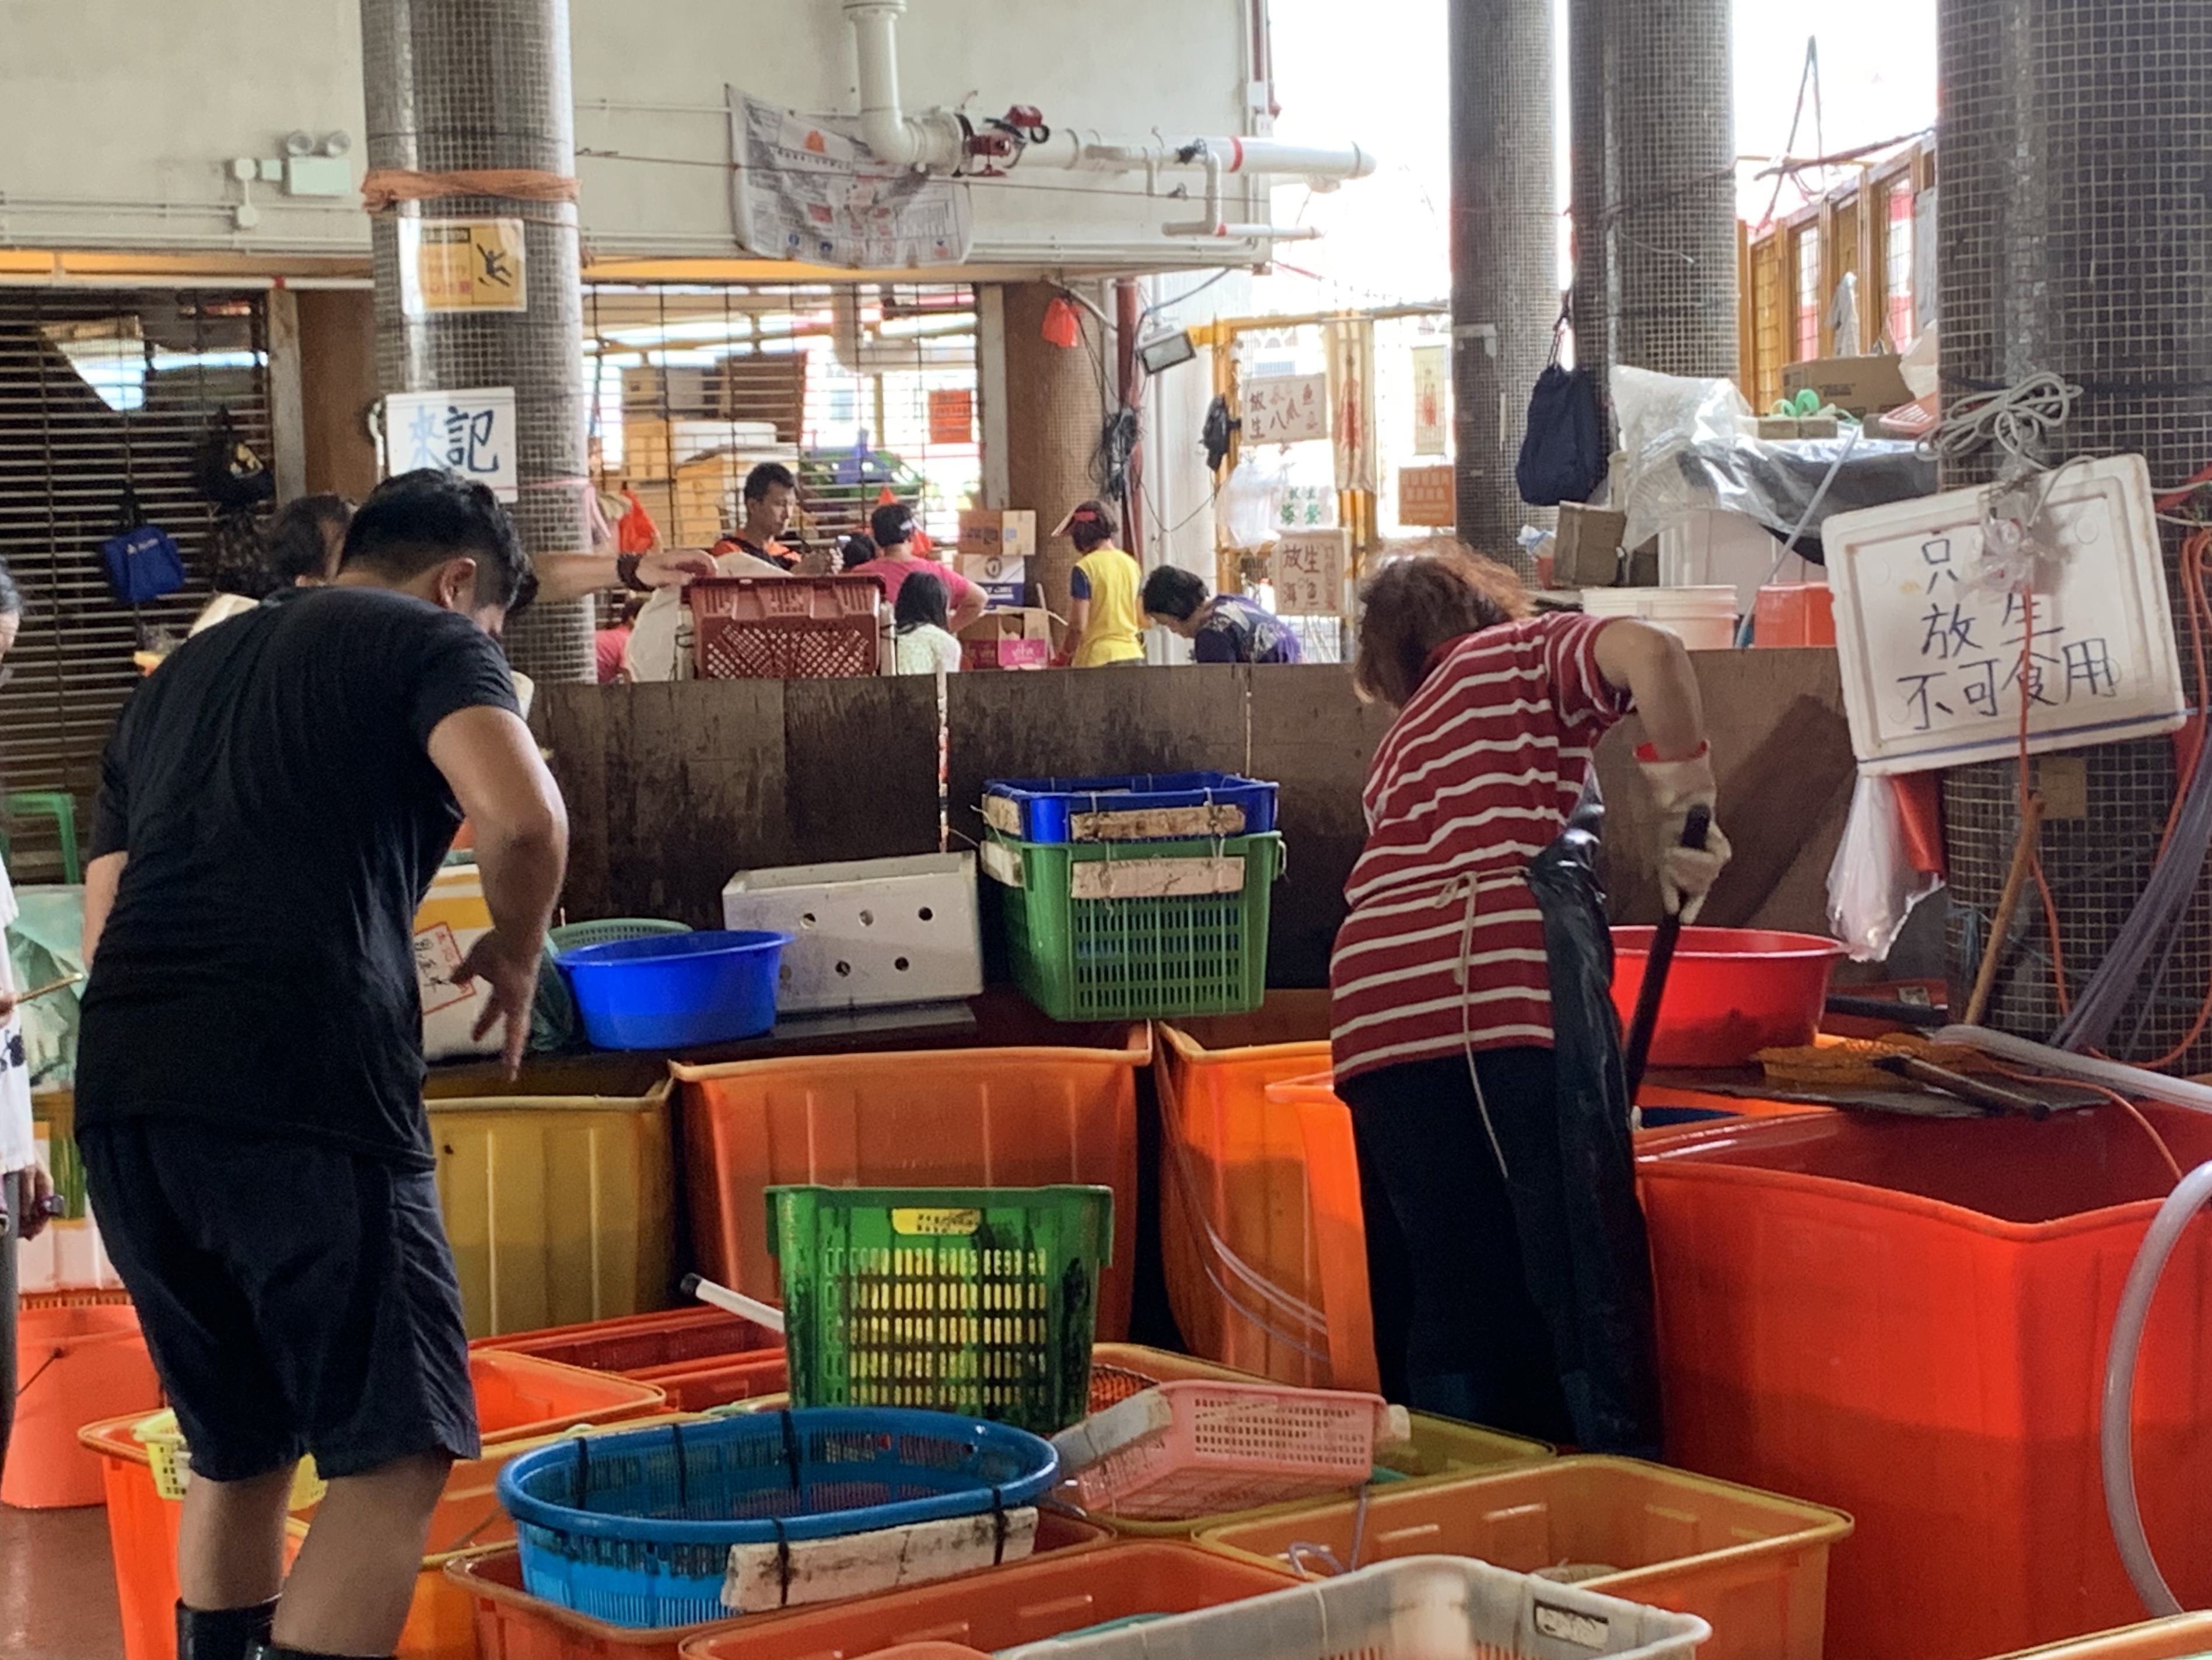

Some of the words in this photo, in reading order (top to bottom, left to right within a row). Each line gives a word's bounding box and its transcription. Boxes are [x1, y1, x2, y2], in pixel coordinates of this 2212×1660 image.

[1283, 544, 1320, 573] 放生
[1922, 593, 2065, 659] 放生
[1896, 638, 2116, 730] 不可食用
